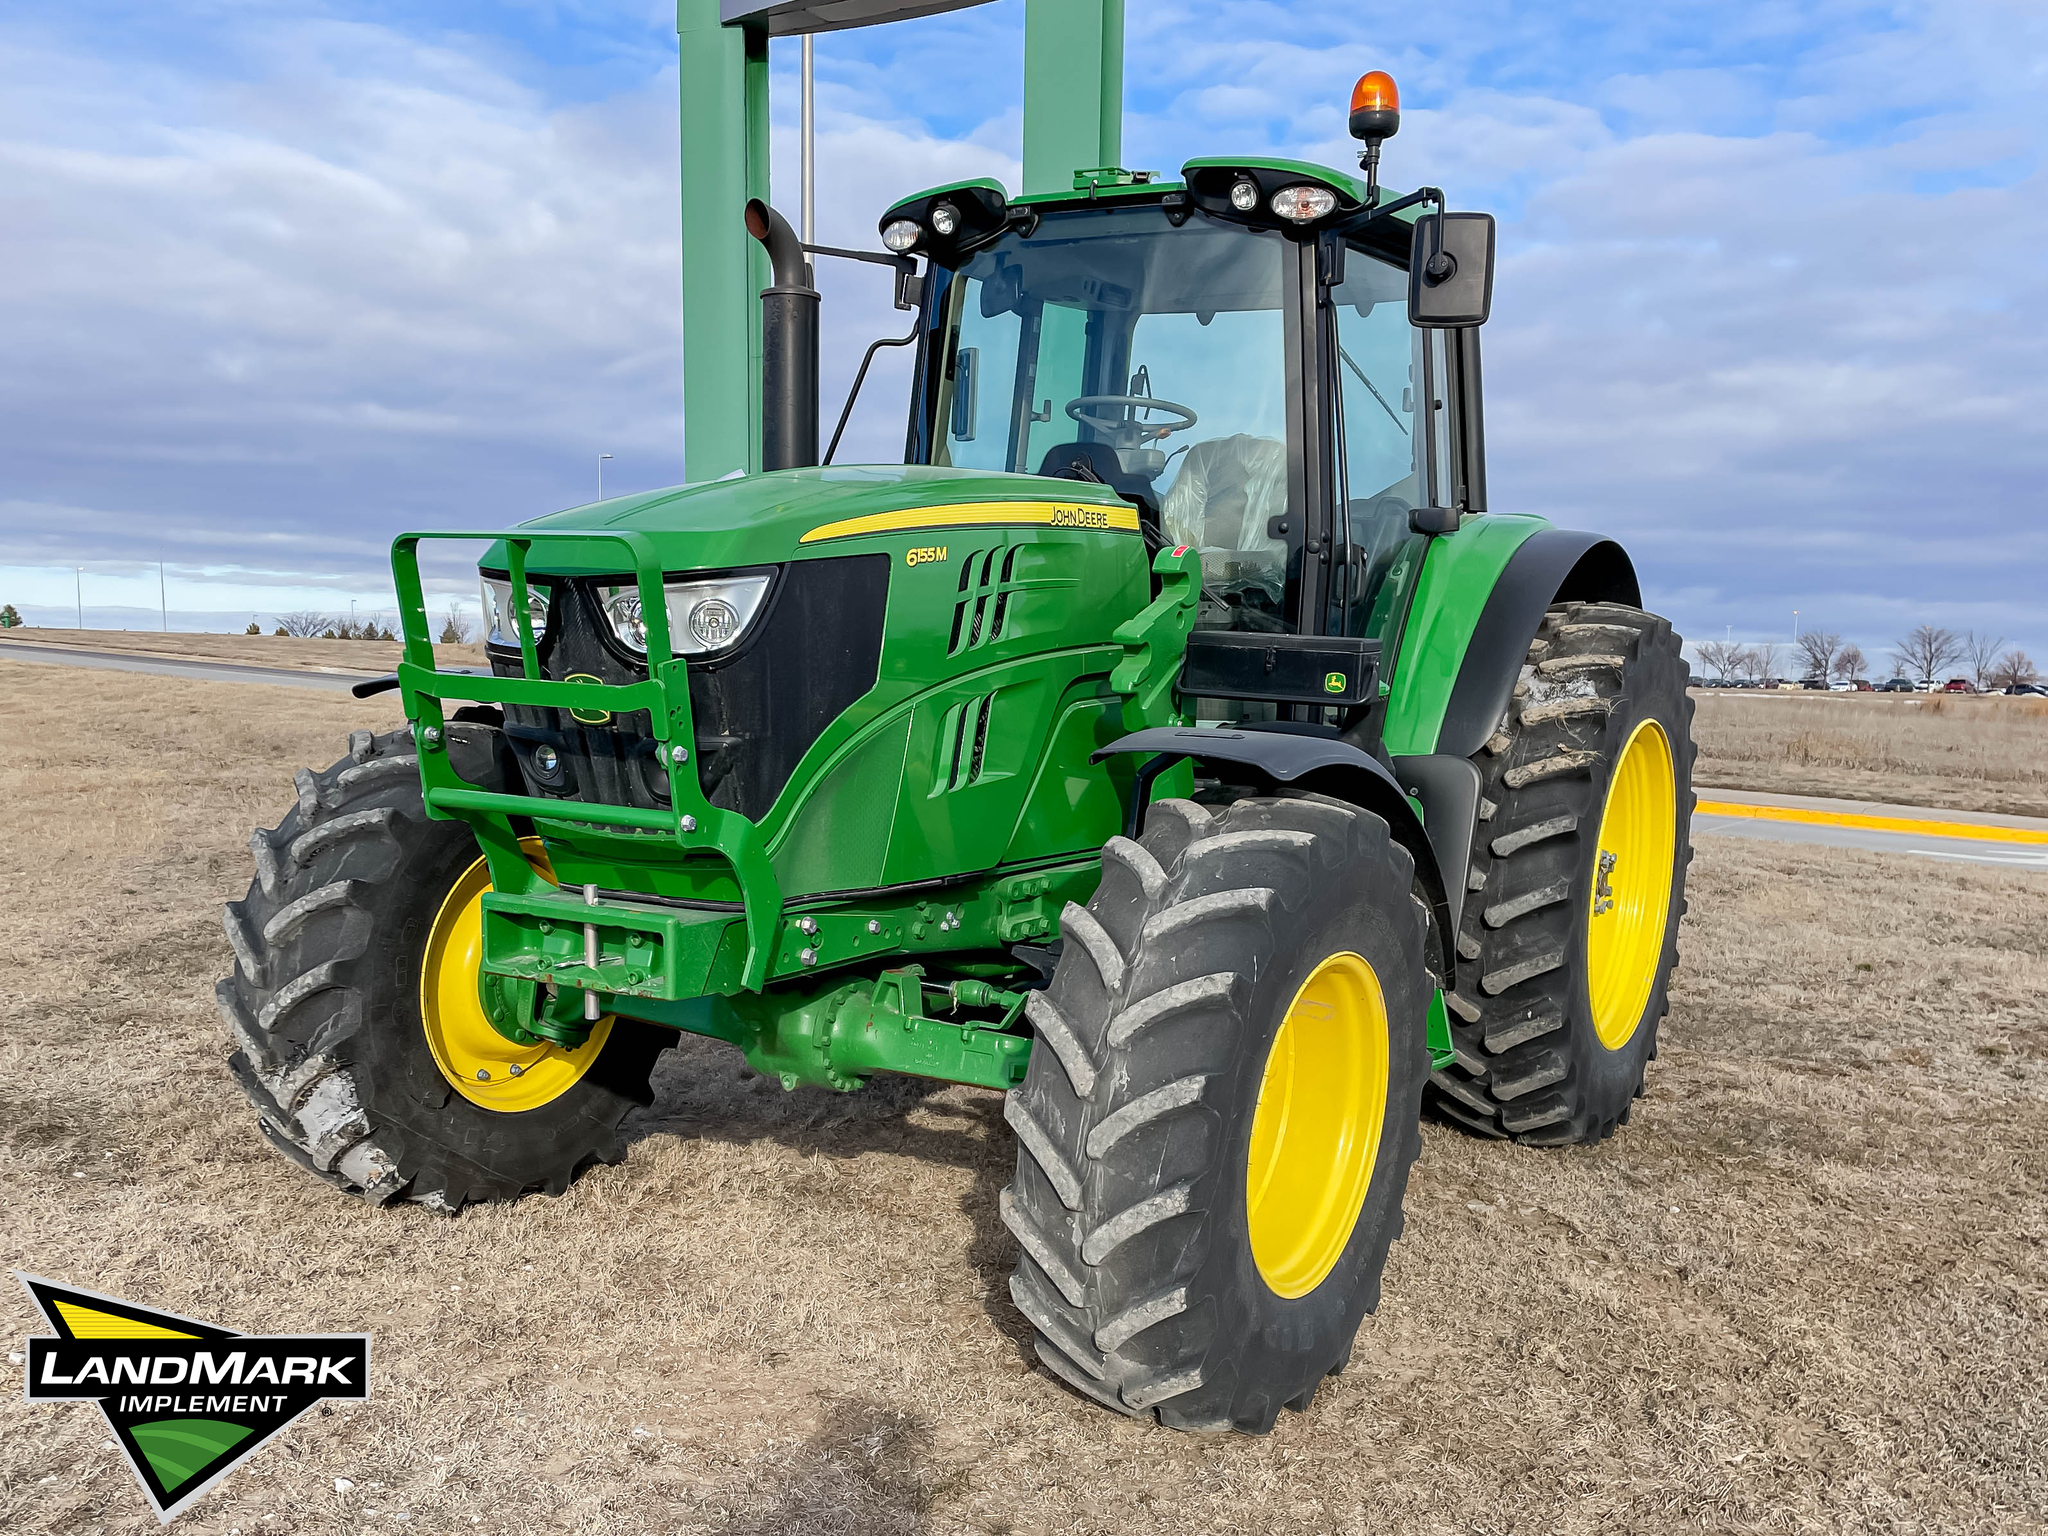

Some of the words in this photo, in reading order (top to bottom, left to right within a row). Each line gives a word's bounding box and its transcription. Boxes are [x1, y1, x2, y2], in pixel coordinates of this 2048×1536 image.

[1050, 506, 1077, 525] JOHN
[1077, 507, 1108, 527] DEERE
[906, 546, 948, 567] 6155M
